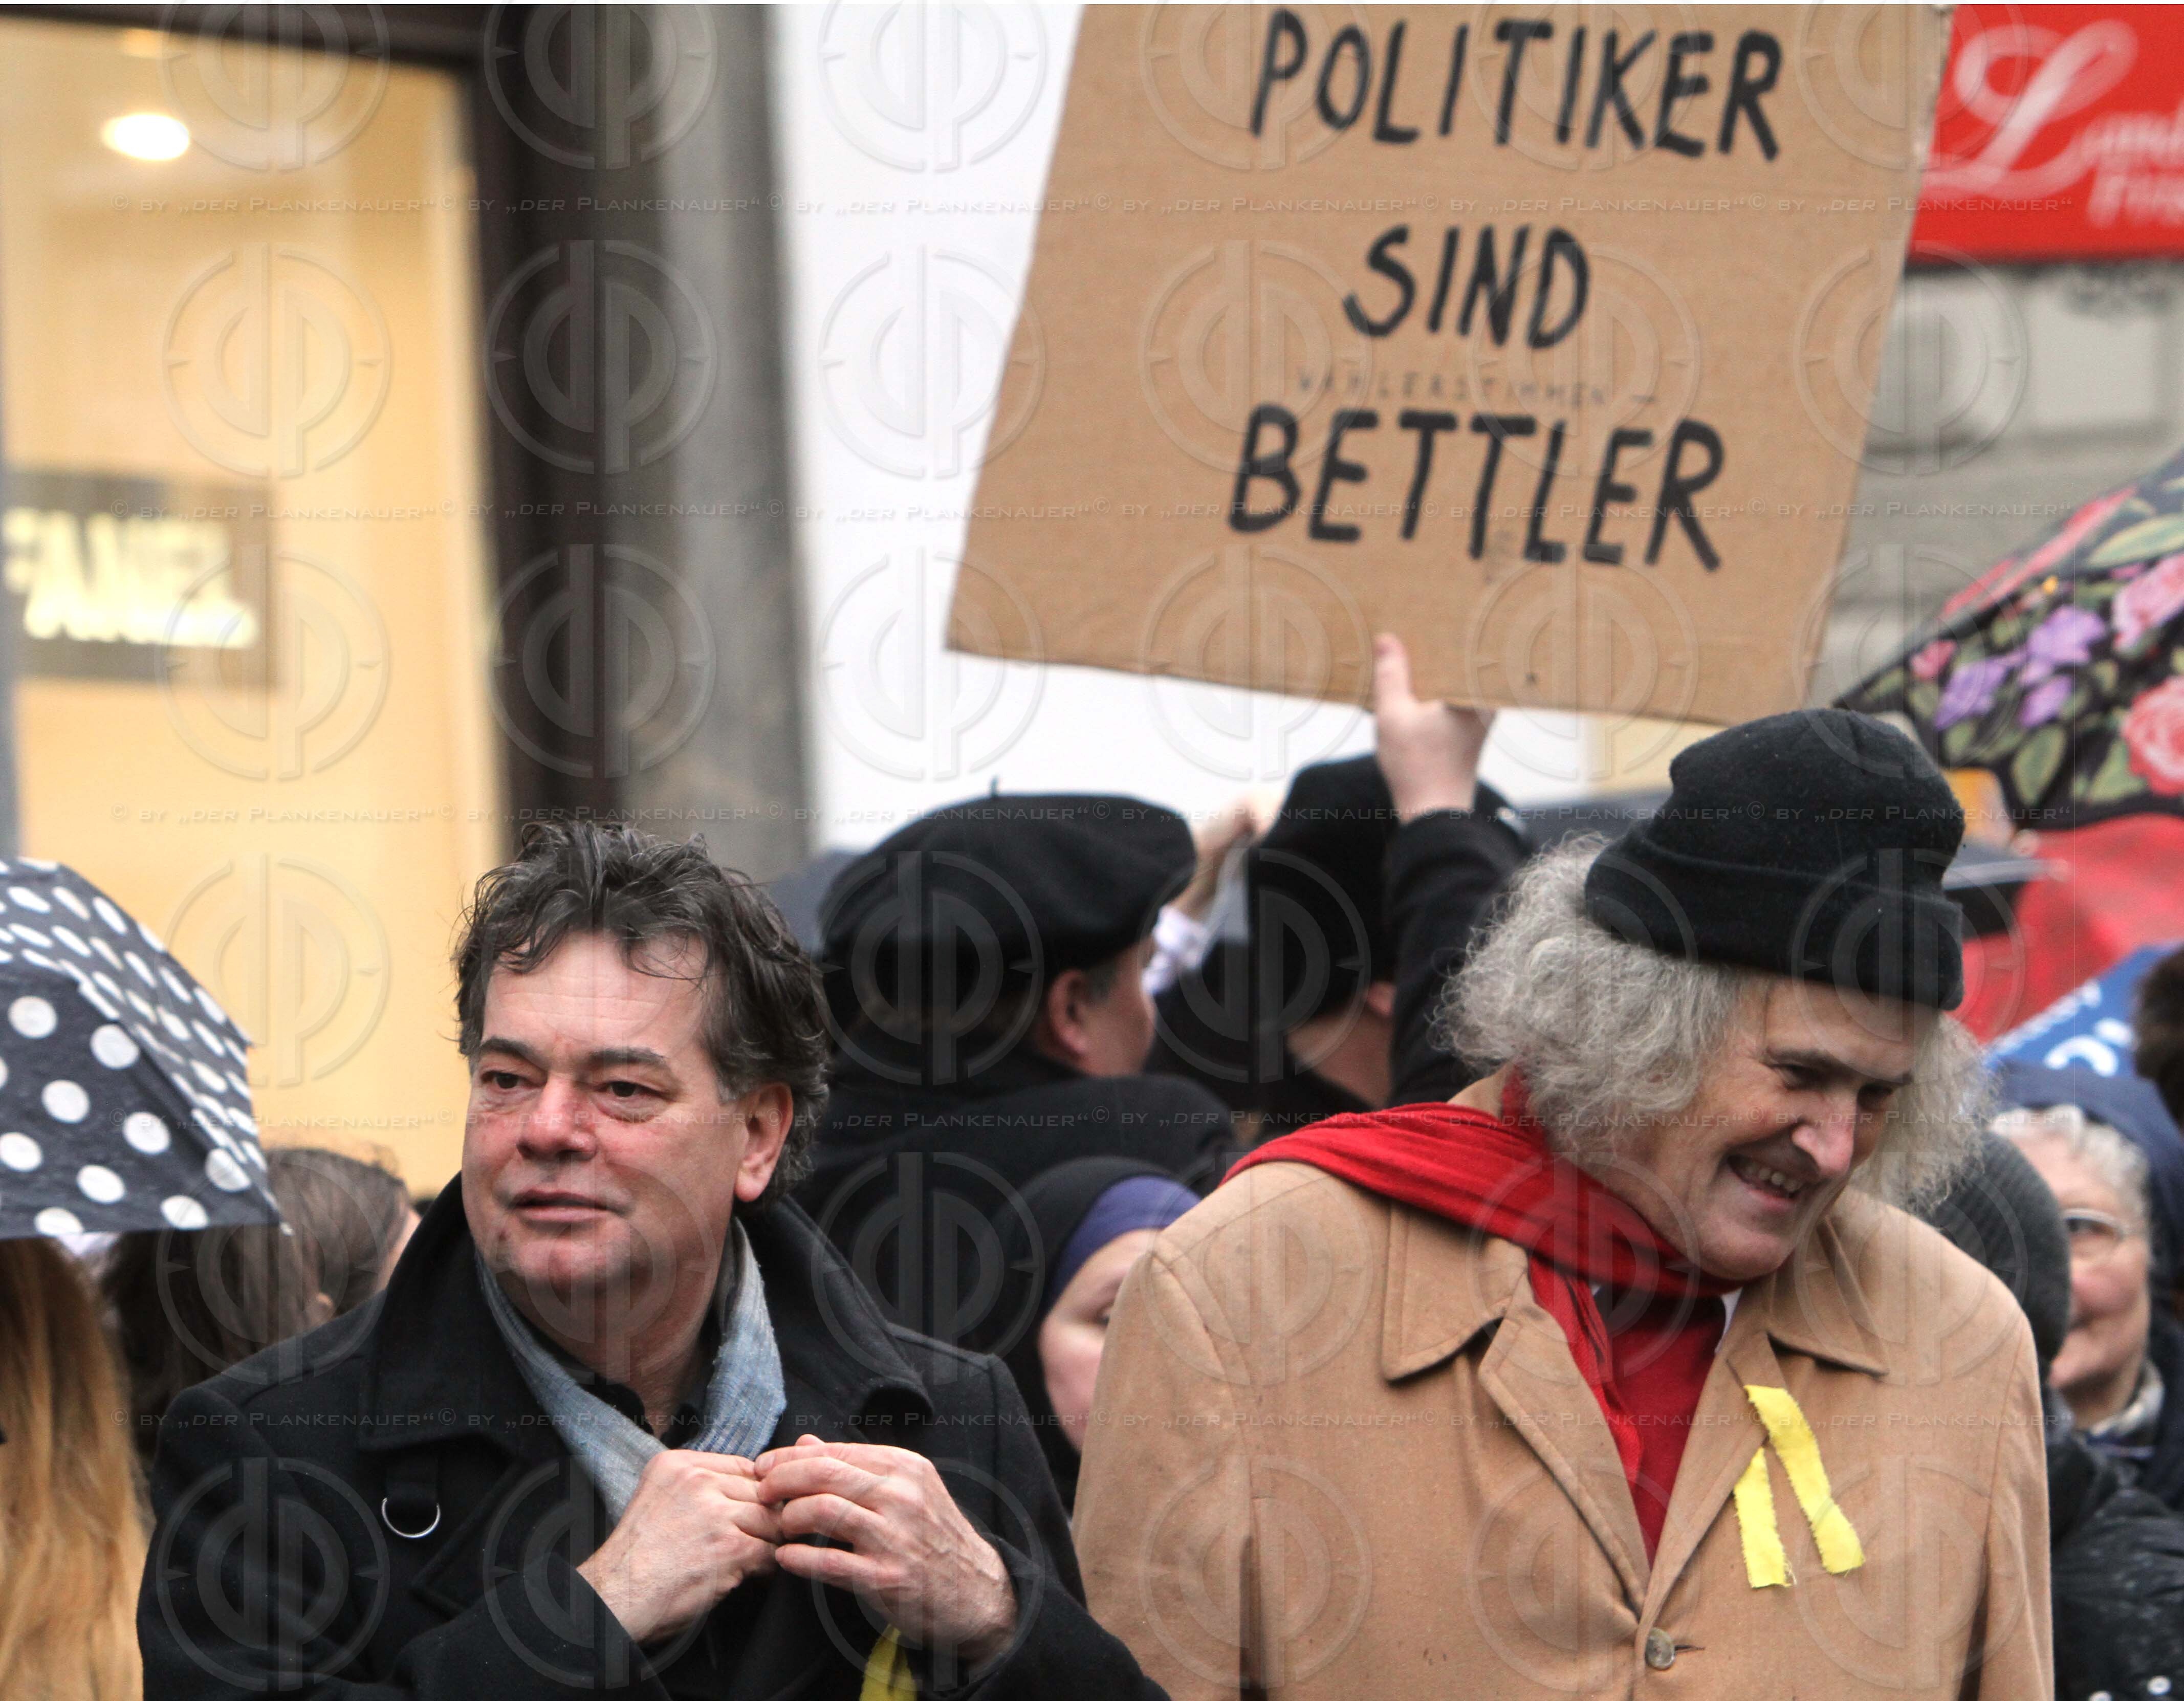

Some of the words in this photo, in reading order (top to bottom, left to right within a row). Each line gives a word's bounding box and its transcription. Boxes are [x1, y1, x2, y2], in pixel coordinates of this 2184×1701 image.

[1251, 10, 1782, 161] POLITIKER
[1344, 226, 1589, 350] SIND
[1228, 405, 1724, 571] BETTLER
